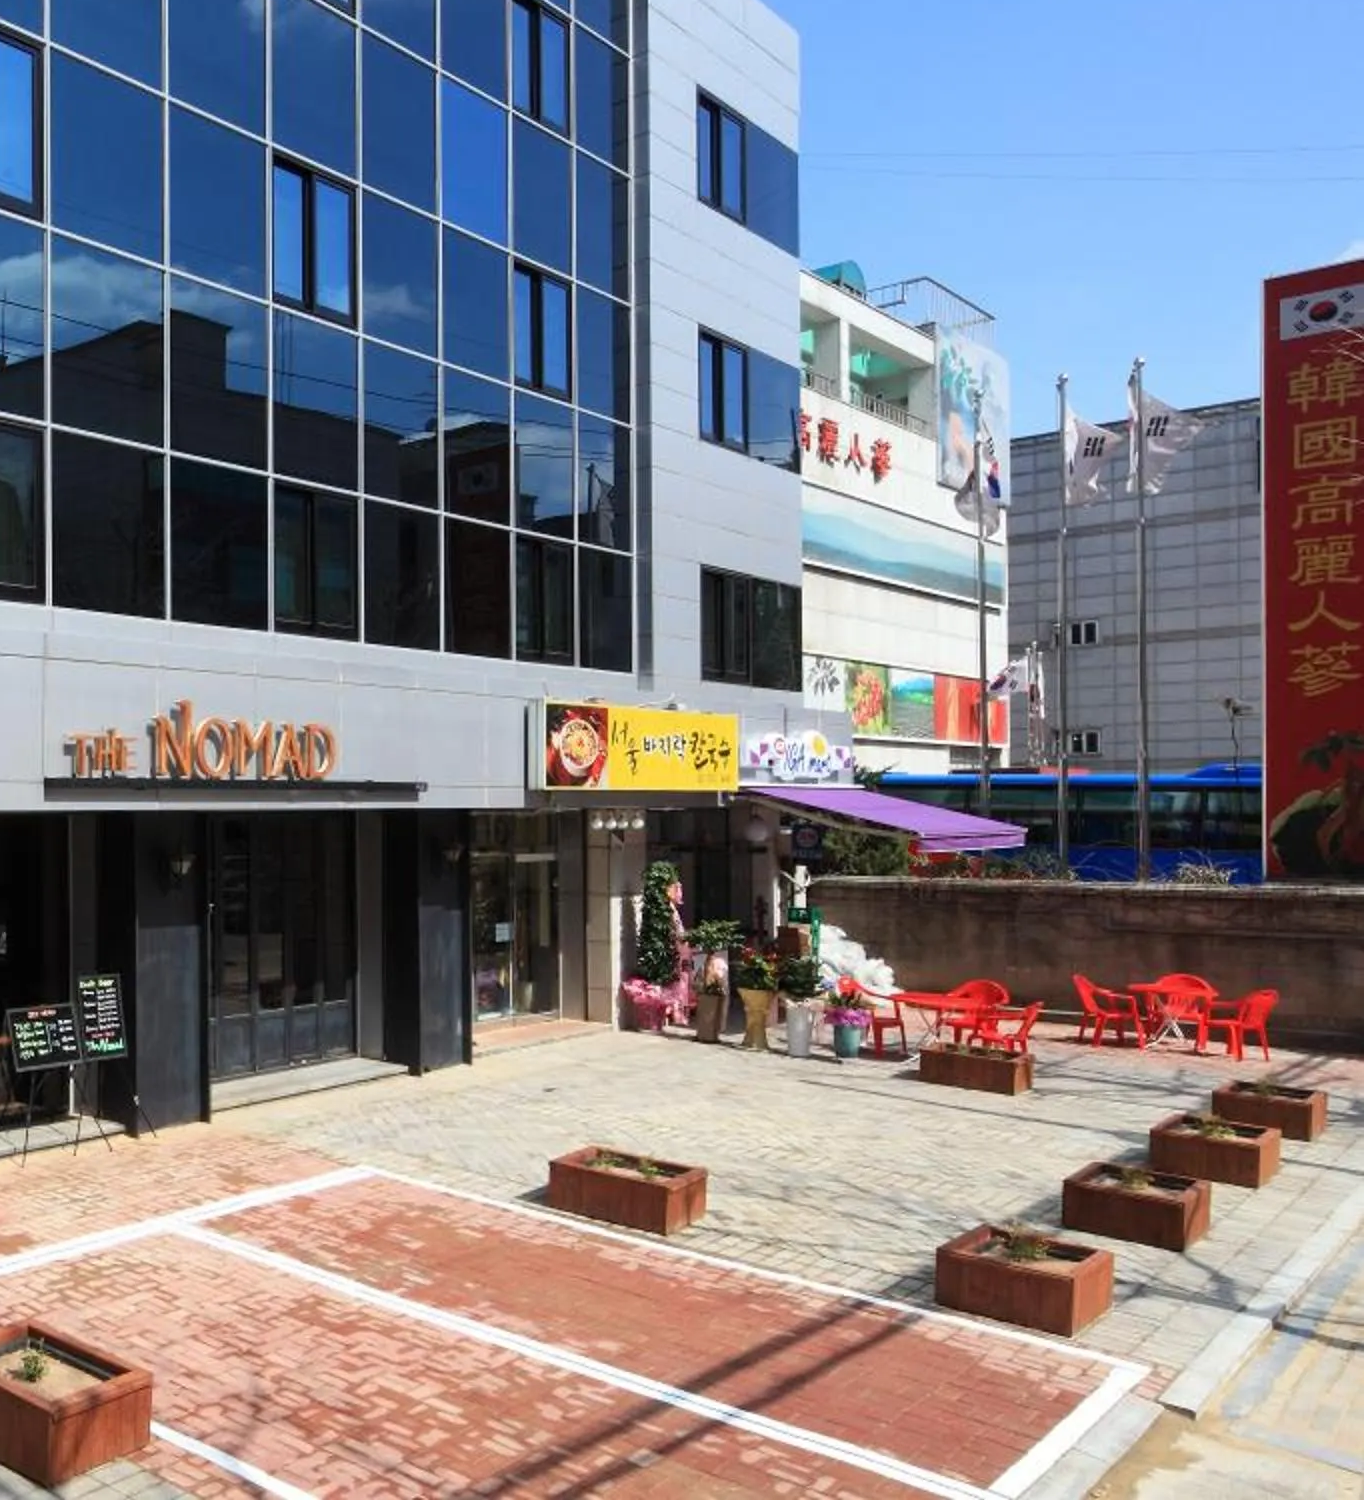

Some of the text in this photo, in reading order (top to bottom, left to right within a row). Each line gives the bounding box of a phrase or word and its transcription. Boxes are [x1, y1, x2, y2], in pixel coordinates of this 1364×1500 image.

[64, 727, 137, 777] THE
[643, 734, 687, 760] 바지락
[689, 729, 731, 772] 칼국수
